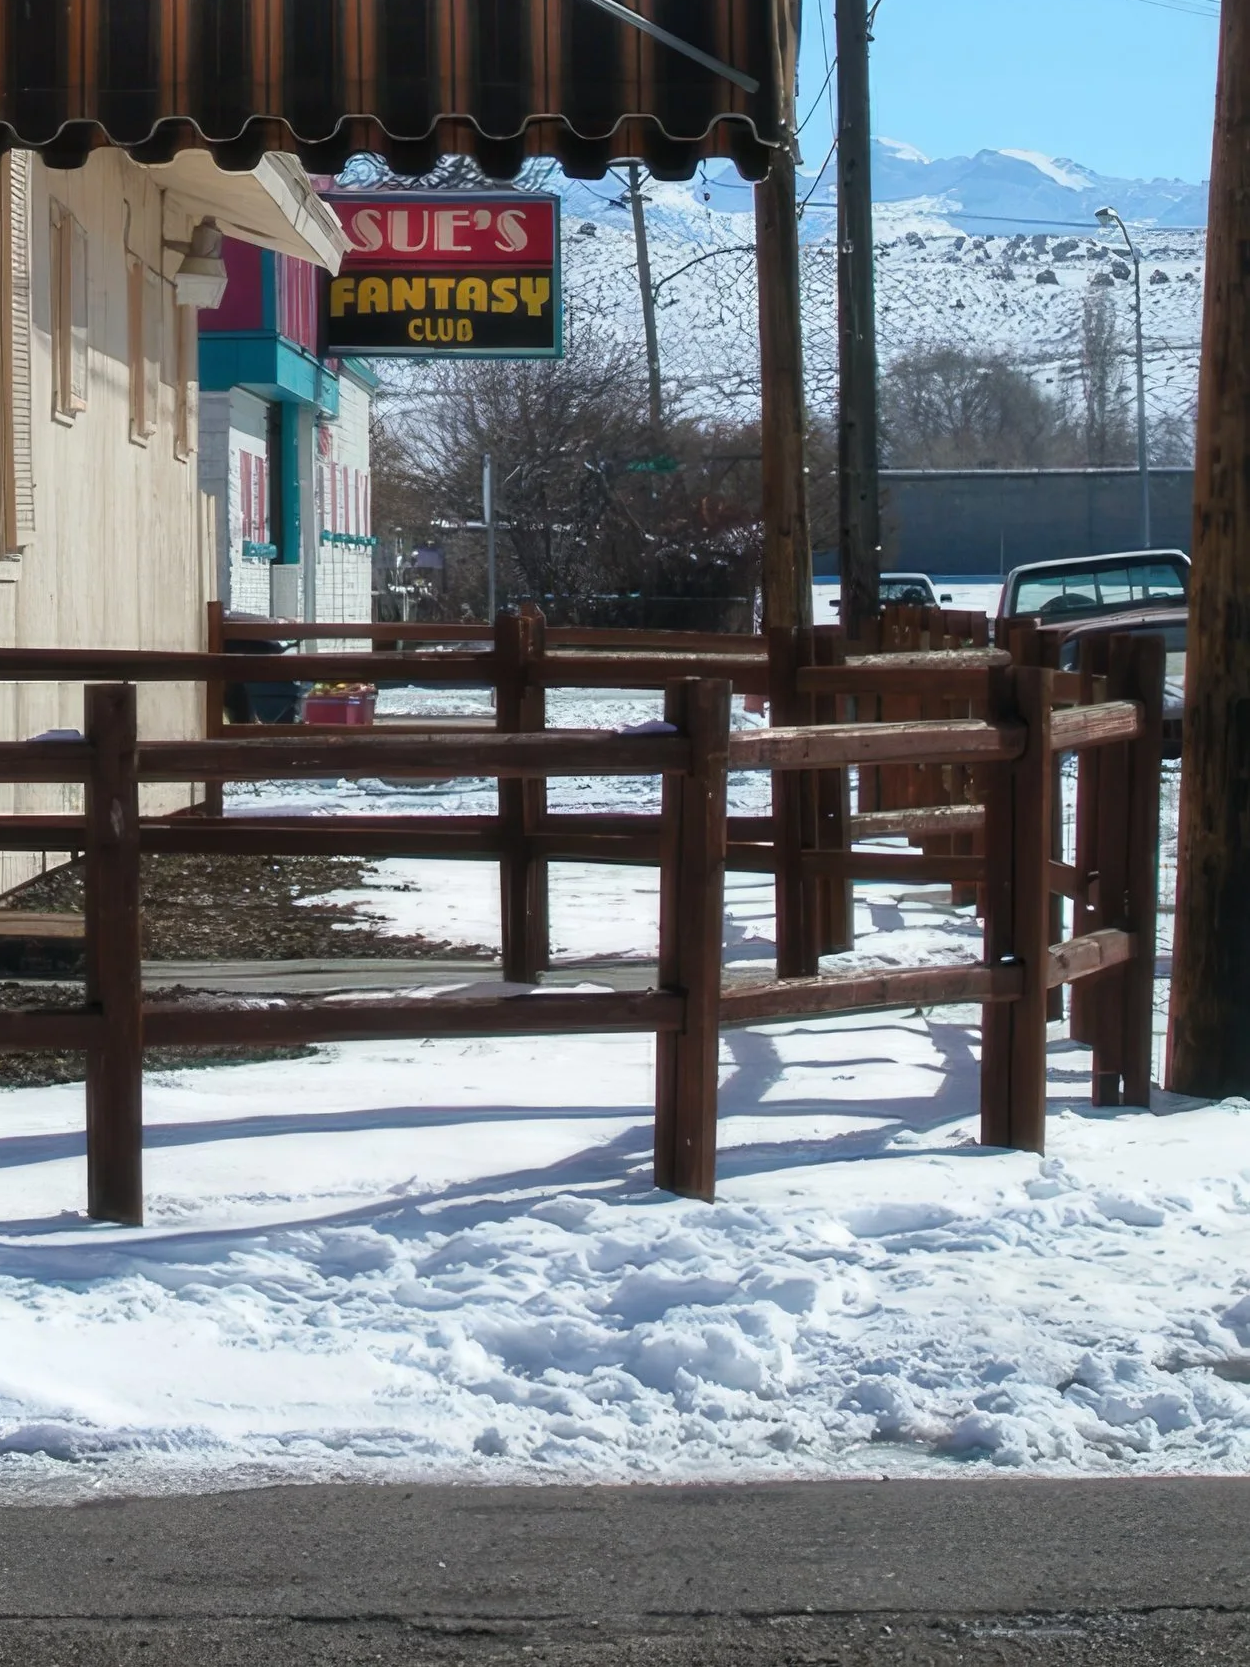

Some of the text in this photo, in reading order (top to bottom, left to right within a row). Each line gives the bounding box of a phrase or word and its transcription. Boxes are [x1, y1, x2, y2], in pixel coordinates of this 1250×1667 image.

[349, 209, 528, 253] SUE'S
[330, 277, 550, 317] FANTASY
[408, 317, 473, 342] CLUB
